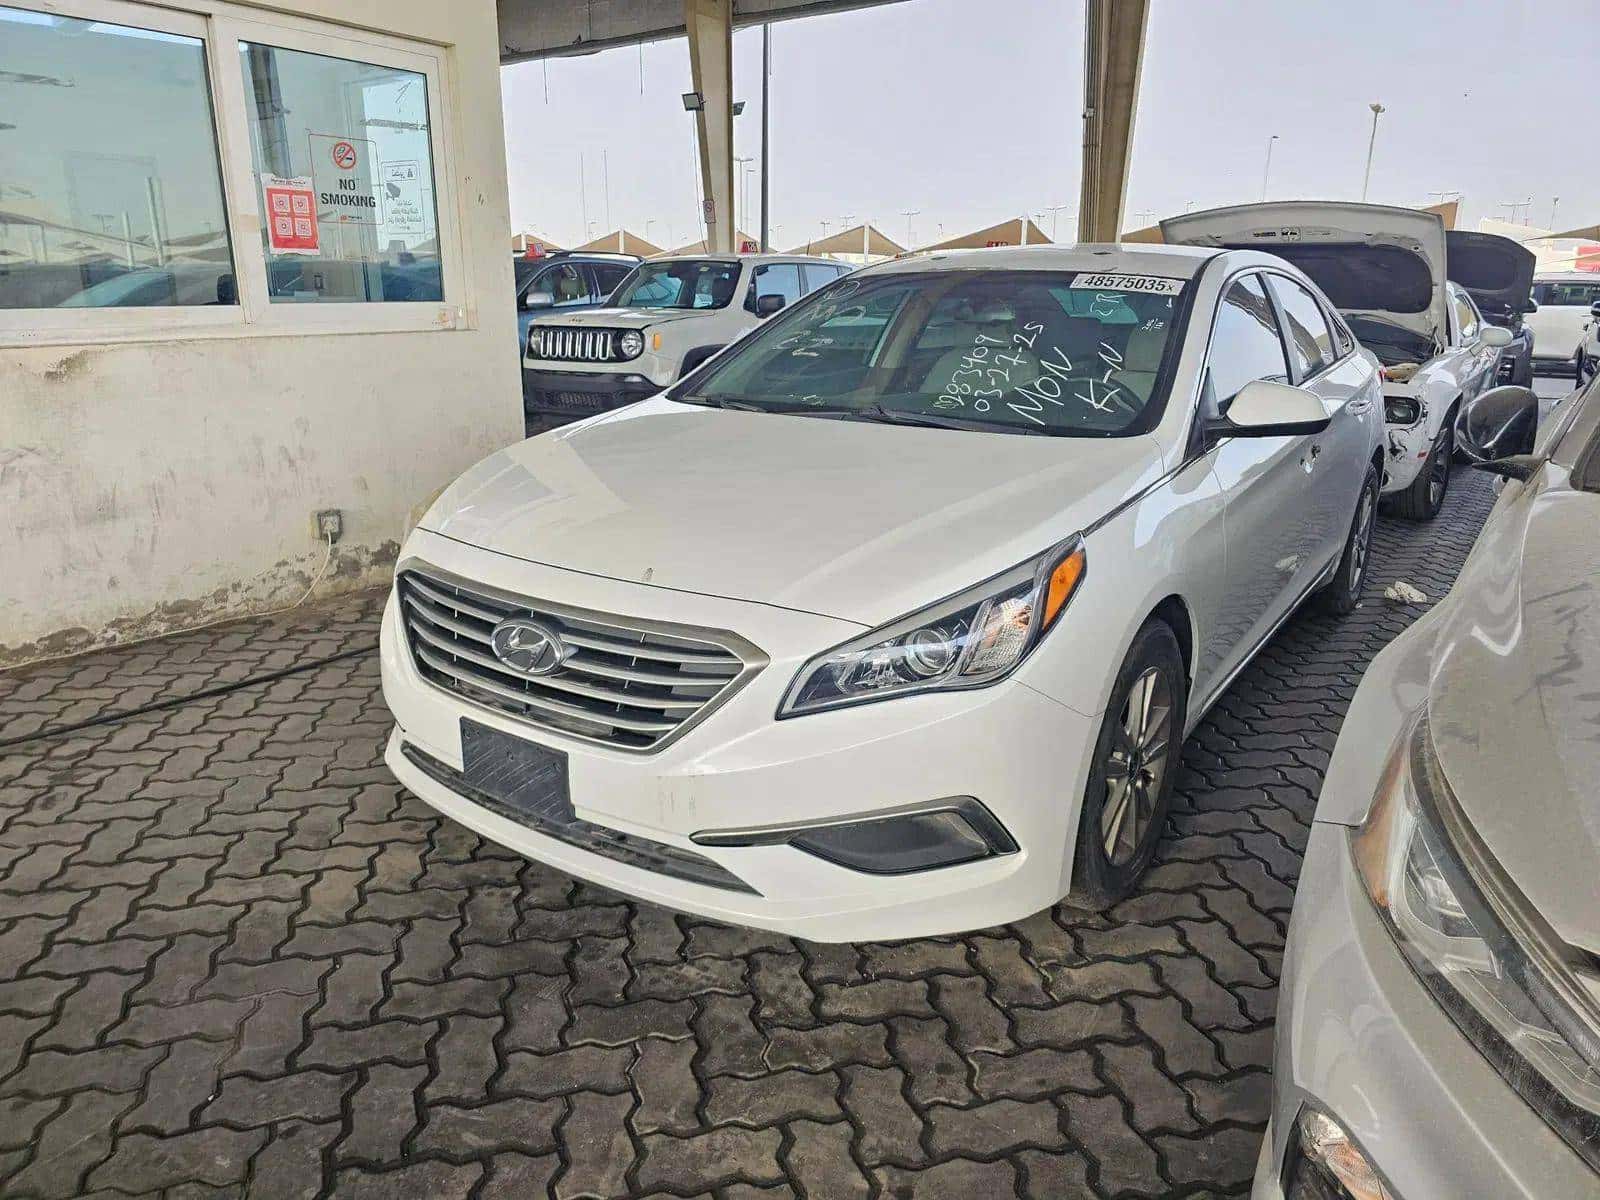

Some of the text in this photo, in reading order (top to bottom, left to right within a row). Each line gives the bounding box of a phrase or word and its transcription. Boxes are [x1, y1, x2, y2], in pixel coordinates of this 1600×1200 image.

[339, 178, 356, 191] NO
[321, 192, 376, 208] SMOKING
[1006, 346, 1073, 426] MON
